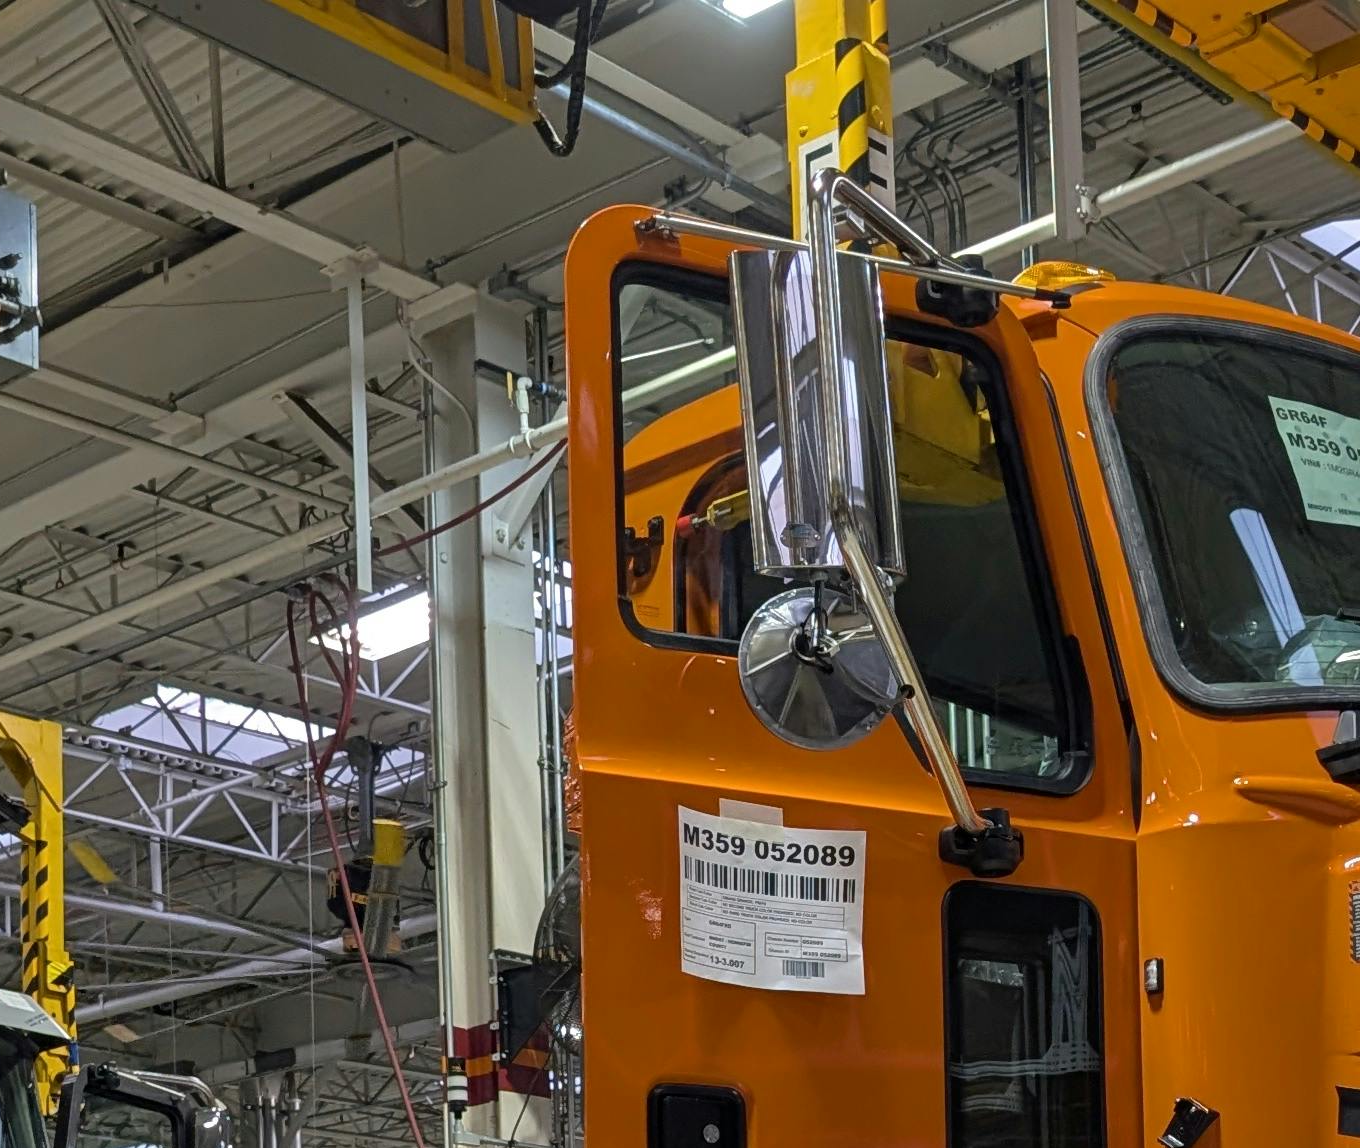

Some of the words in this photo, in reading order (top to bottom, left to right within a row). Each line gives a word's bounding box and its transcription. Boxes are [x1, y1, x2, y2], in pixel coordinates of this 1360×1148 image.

[1275, 407, 1327, 429] GR64F
[1286, 432, 1341, 457] M359
[683, 823, 746, 856] M359
[754, 840, 856, 867] 052089
[710, 955, 745, 969] 13-3.007
